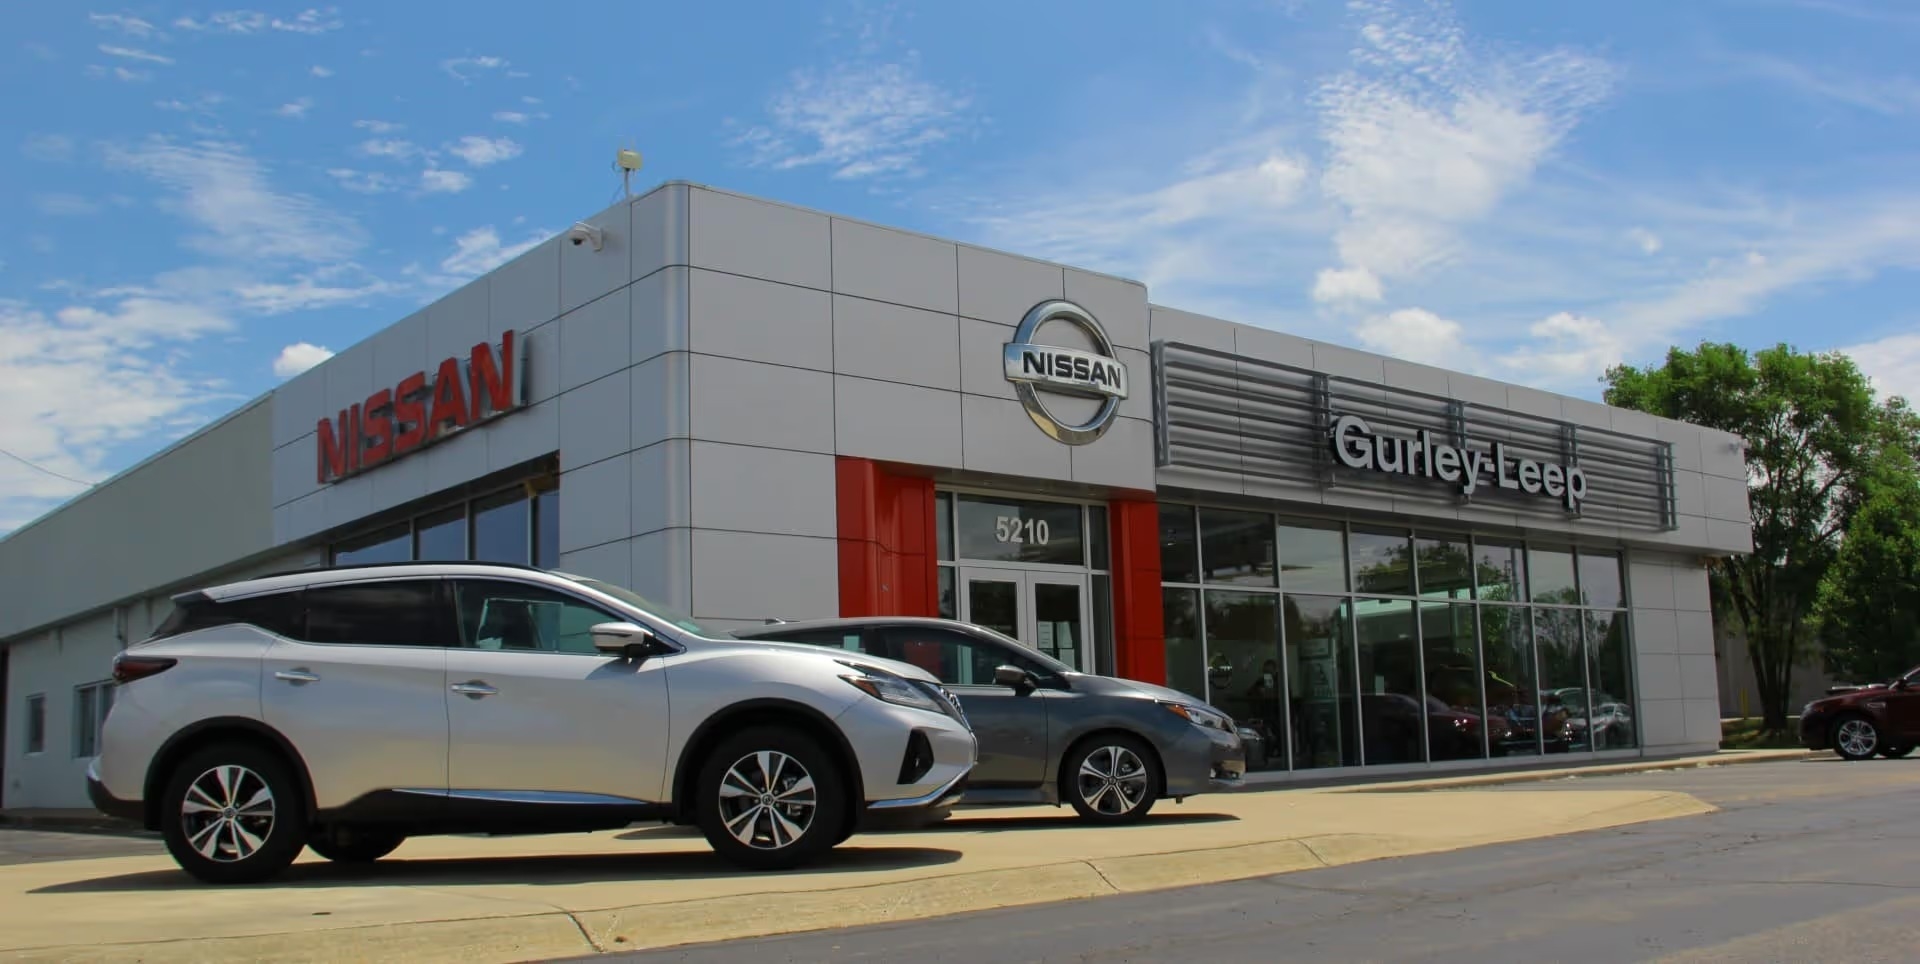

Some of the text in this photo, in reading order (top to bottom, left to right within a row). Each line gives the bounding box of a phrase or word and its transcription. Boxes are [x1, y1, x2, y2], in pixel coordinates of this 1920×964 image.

[1023, 351, 1121, 389] NISSAN
[317, 329, 516, 485] NISSAN
[1334, 415, 1587, 509] Gurley-Leep
[996, 516, 1049, 545] 5210
